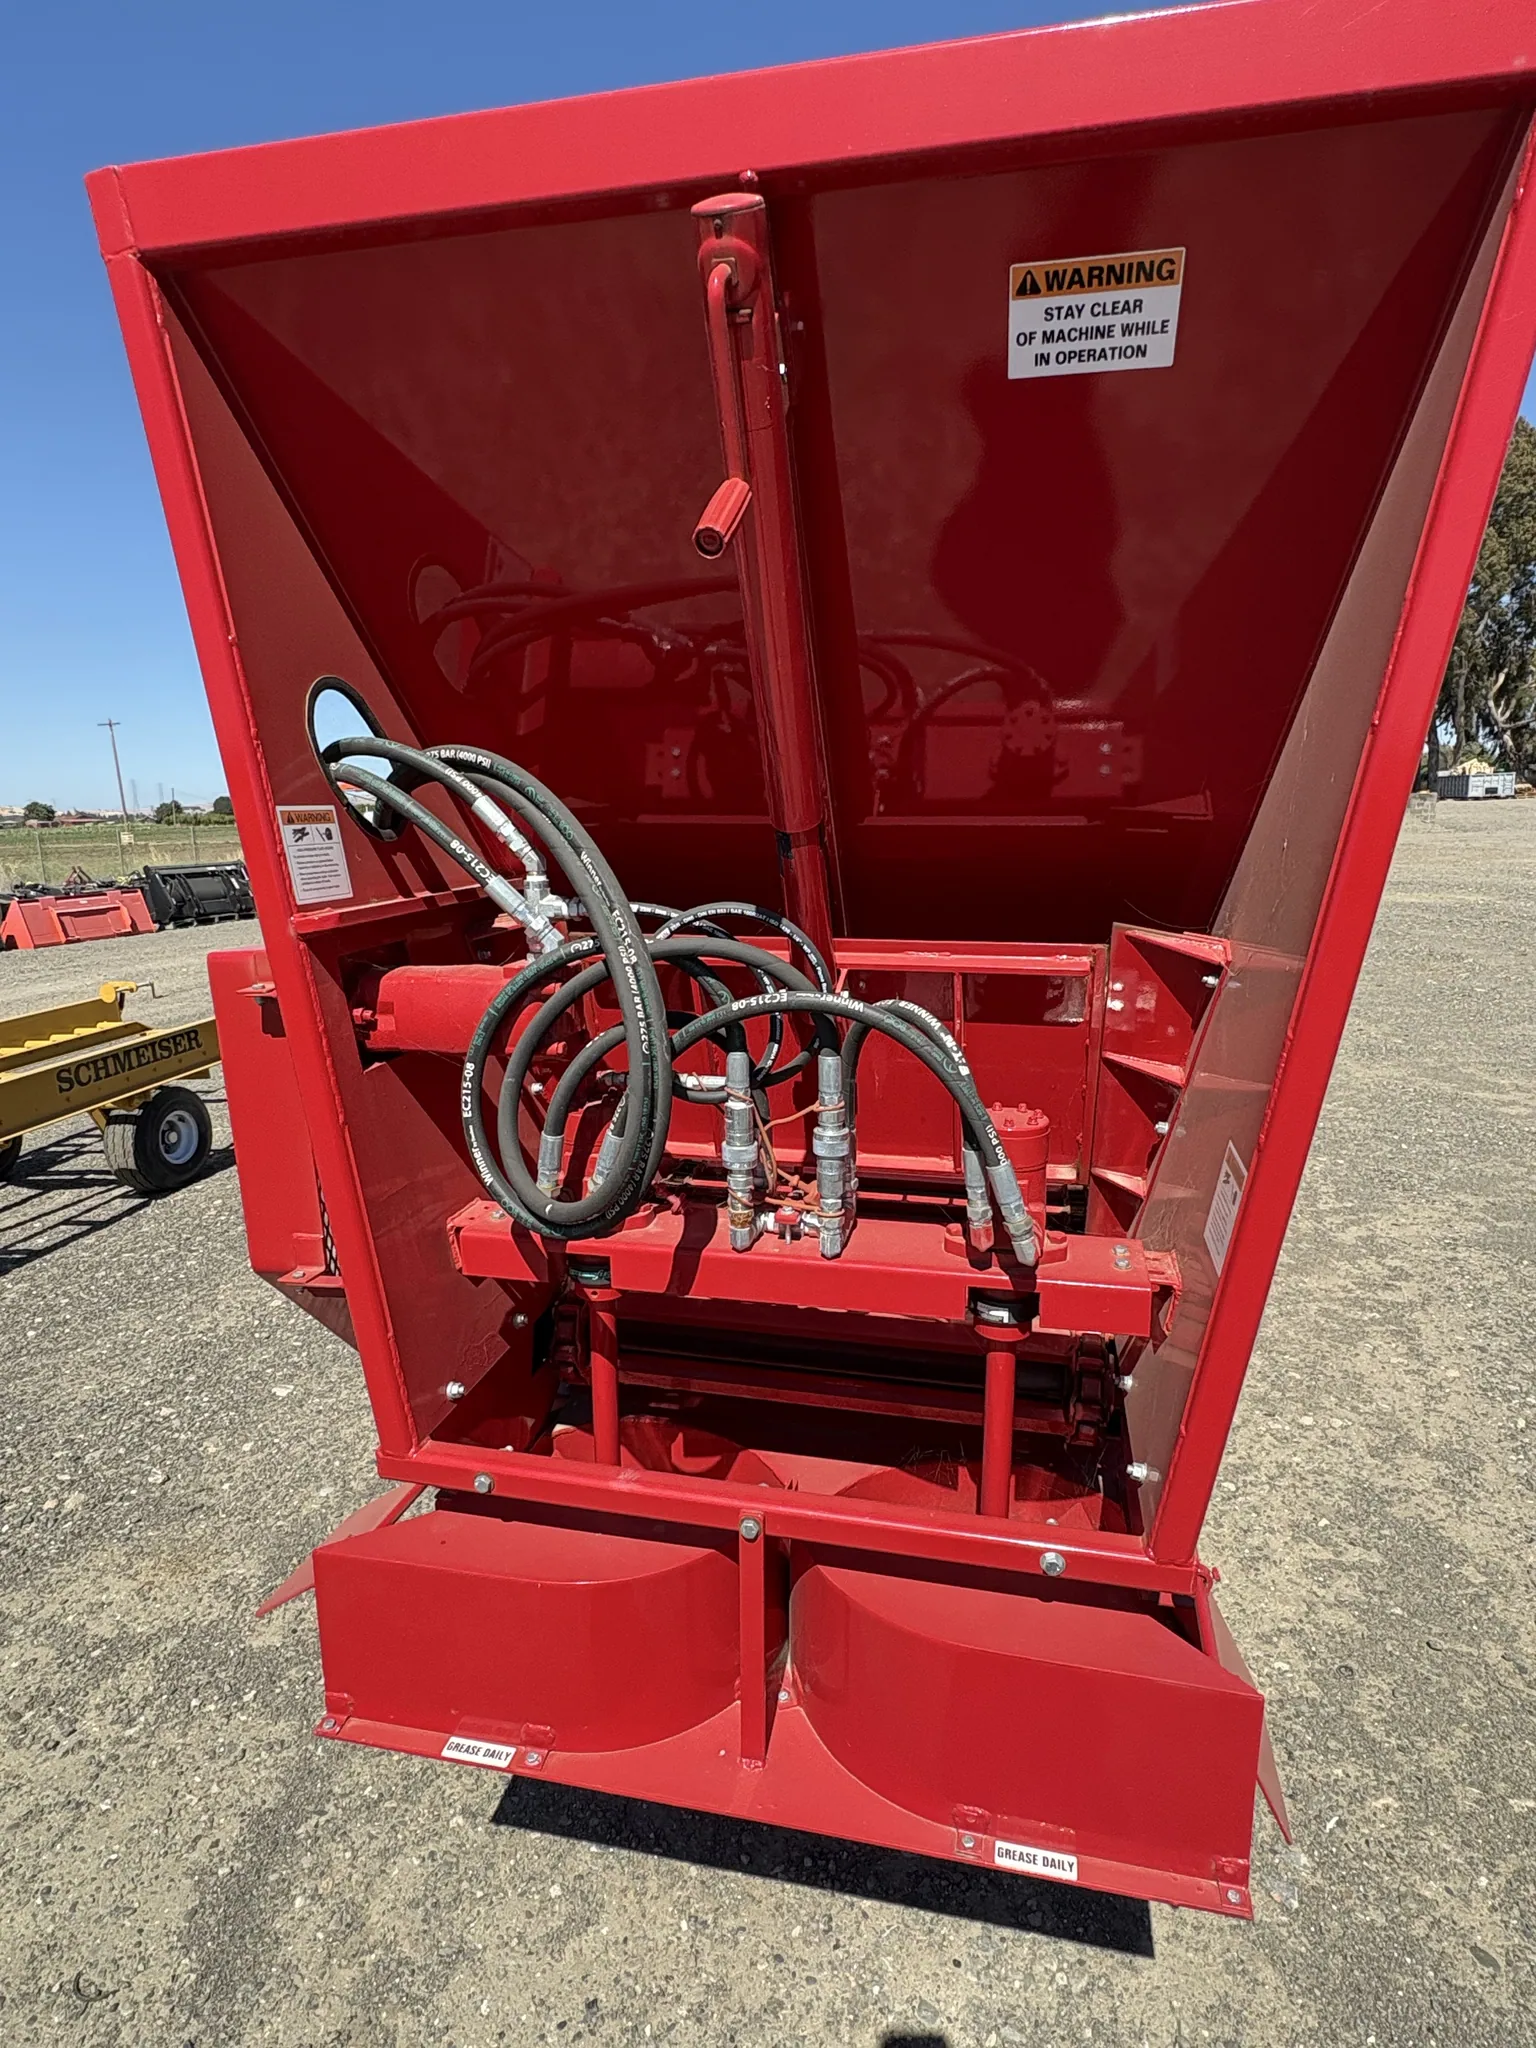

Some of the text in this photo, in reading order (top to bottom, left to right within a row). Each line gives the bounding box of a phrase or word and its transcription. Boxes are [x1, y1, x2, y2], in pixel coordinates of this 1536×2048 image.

[1044, 258, 1176, 292] WARNING
[1044, 299, 1144, 322] STAY CLEAR
[1016, 319, 1170, 347] OF MACHINE WHILE
[1034, 344, 1148, 367] IN OPERATION
[440, 749, 456, 759] BAR
[294, 813, 330, 822] WARNING
[449, 839, 497, 884] EC215-08
[580, 851, 602, 886] Winner
[732, 992, 864, 1012] Winner EC215-08
[898, 1000, 941, 1030] WINNER
[56, 1028, 202, 1094] SCHMEISER
[462, 1062, 475, 1118] EC215-08
[986, 1124, 999, 1146] PSI)
[472, 1147, 494, 1187] Winner
[447, 1742, 512, 1761] GREASE DAILY
[997, 1847, 1074, 1872] GREASE DAILY
